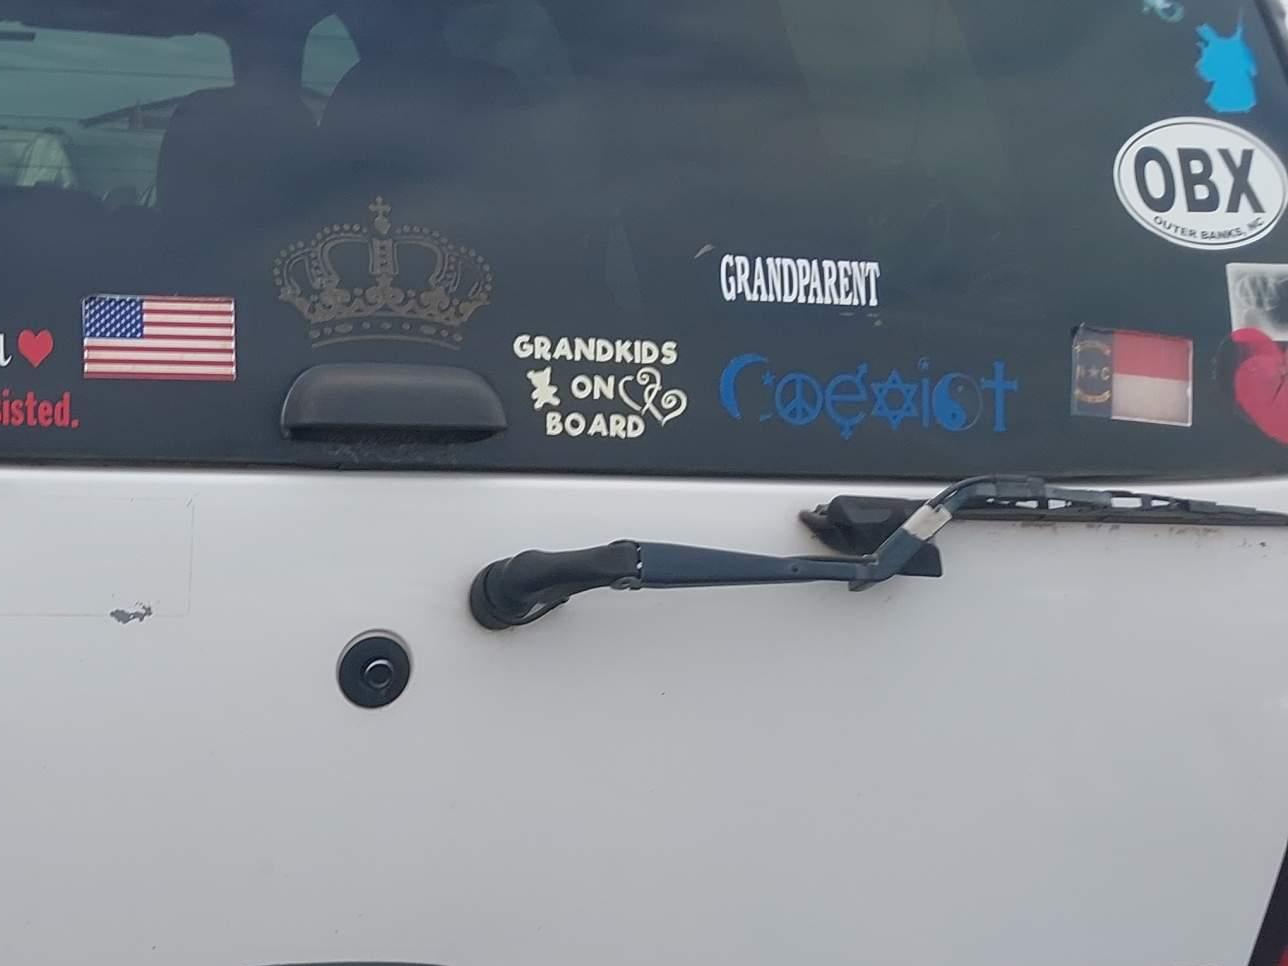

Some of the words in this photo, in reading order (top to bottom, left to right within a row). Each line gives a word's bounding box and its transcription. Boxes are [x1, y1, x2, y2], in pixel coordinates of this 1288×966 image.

[1133, 145, 1266, 214] OBX
[1153, 215, 1198, 238] OUTER
[1247, 216, 1265, 230] NC
[720, 253, 880, 306] GRANDPARENT
[513, 334, 678, 365] GRANDKIDS
[570, 374, 615, 400] ON
[545, 410, 646, 440] BOARD
